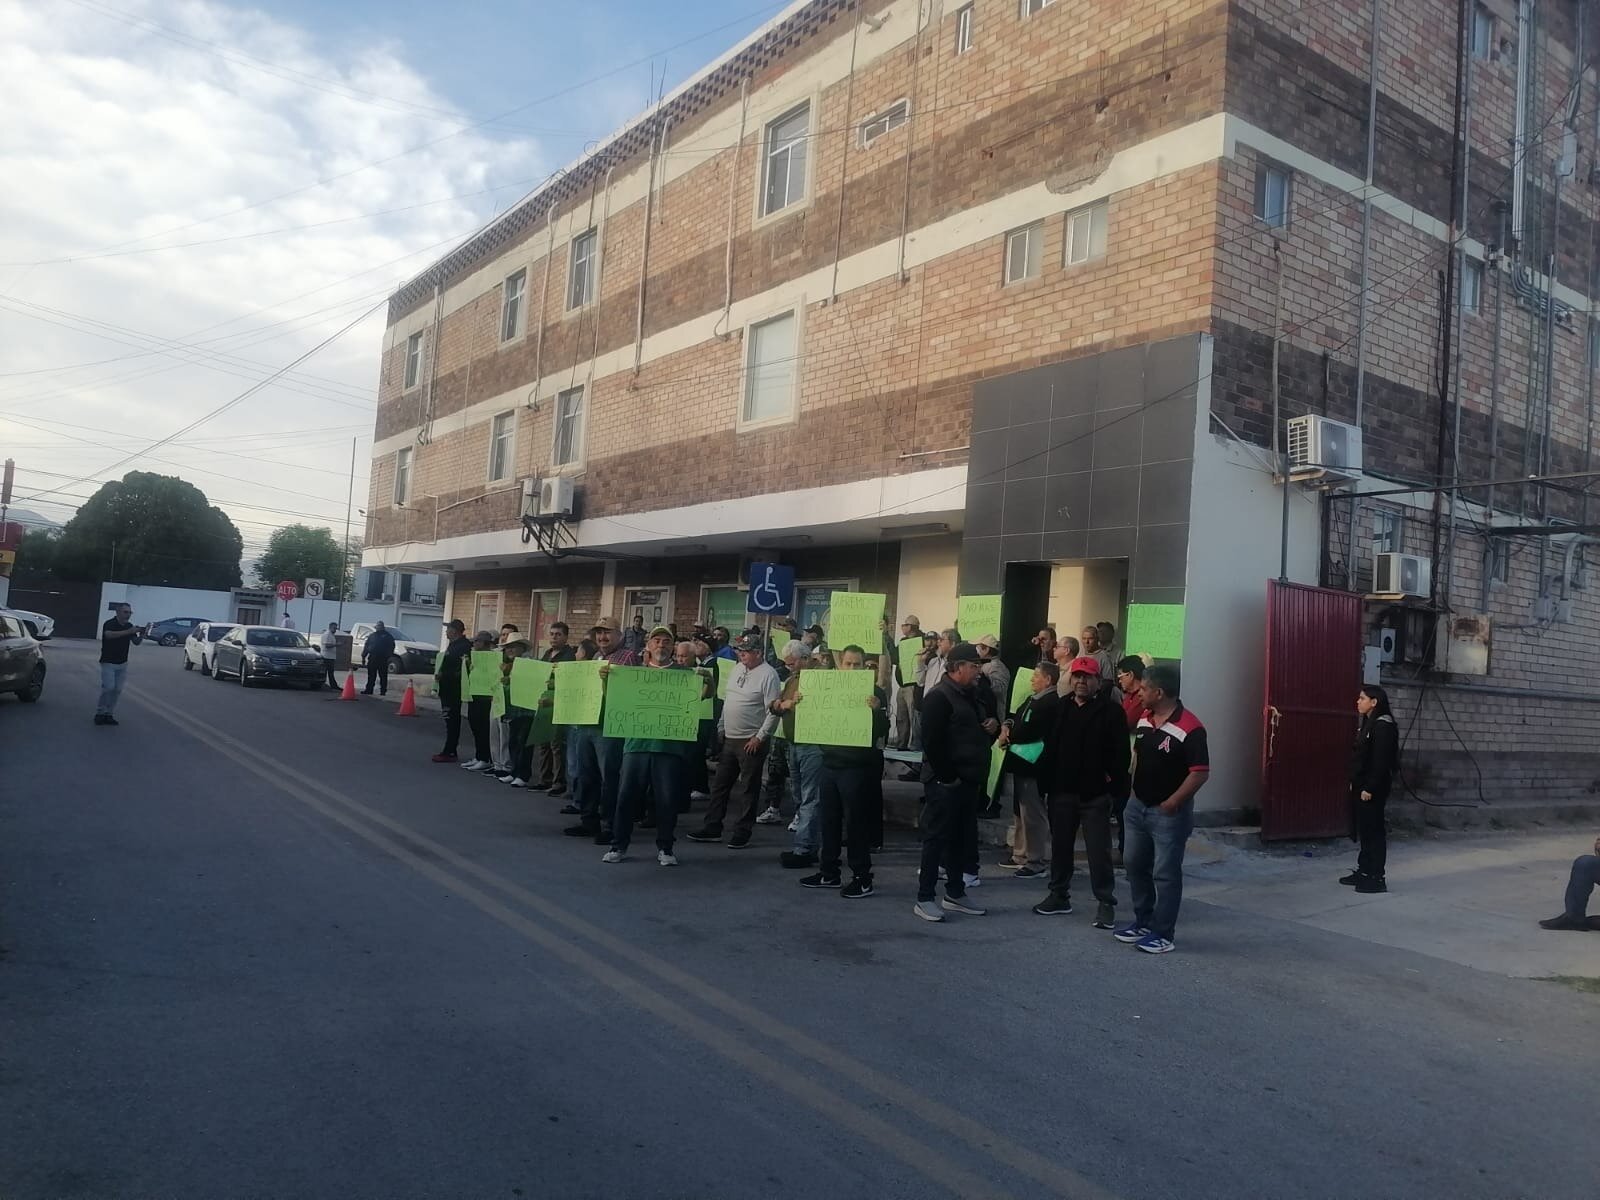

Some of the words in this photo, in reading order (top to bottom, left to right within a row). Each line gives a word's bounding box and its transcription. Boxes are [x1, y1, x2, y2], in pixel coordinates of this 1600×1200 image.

[278, 585, 297, 595] ALTO
[632, 669, 689, 687] JUSTICIA
[608, 708, 647, 722] COMO
[658, 713, 694, 728] DIJO
[609, 723, 625, 736] LA
[632, 723, 697, 738] PRESIDENTA
